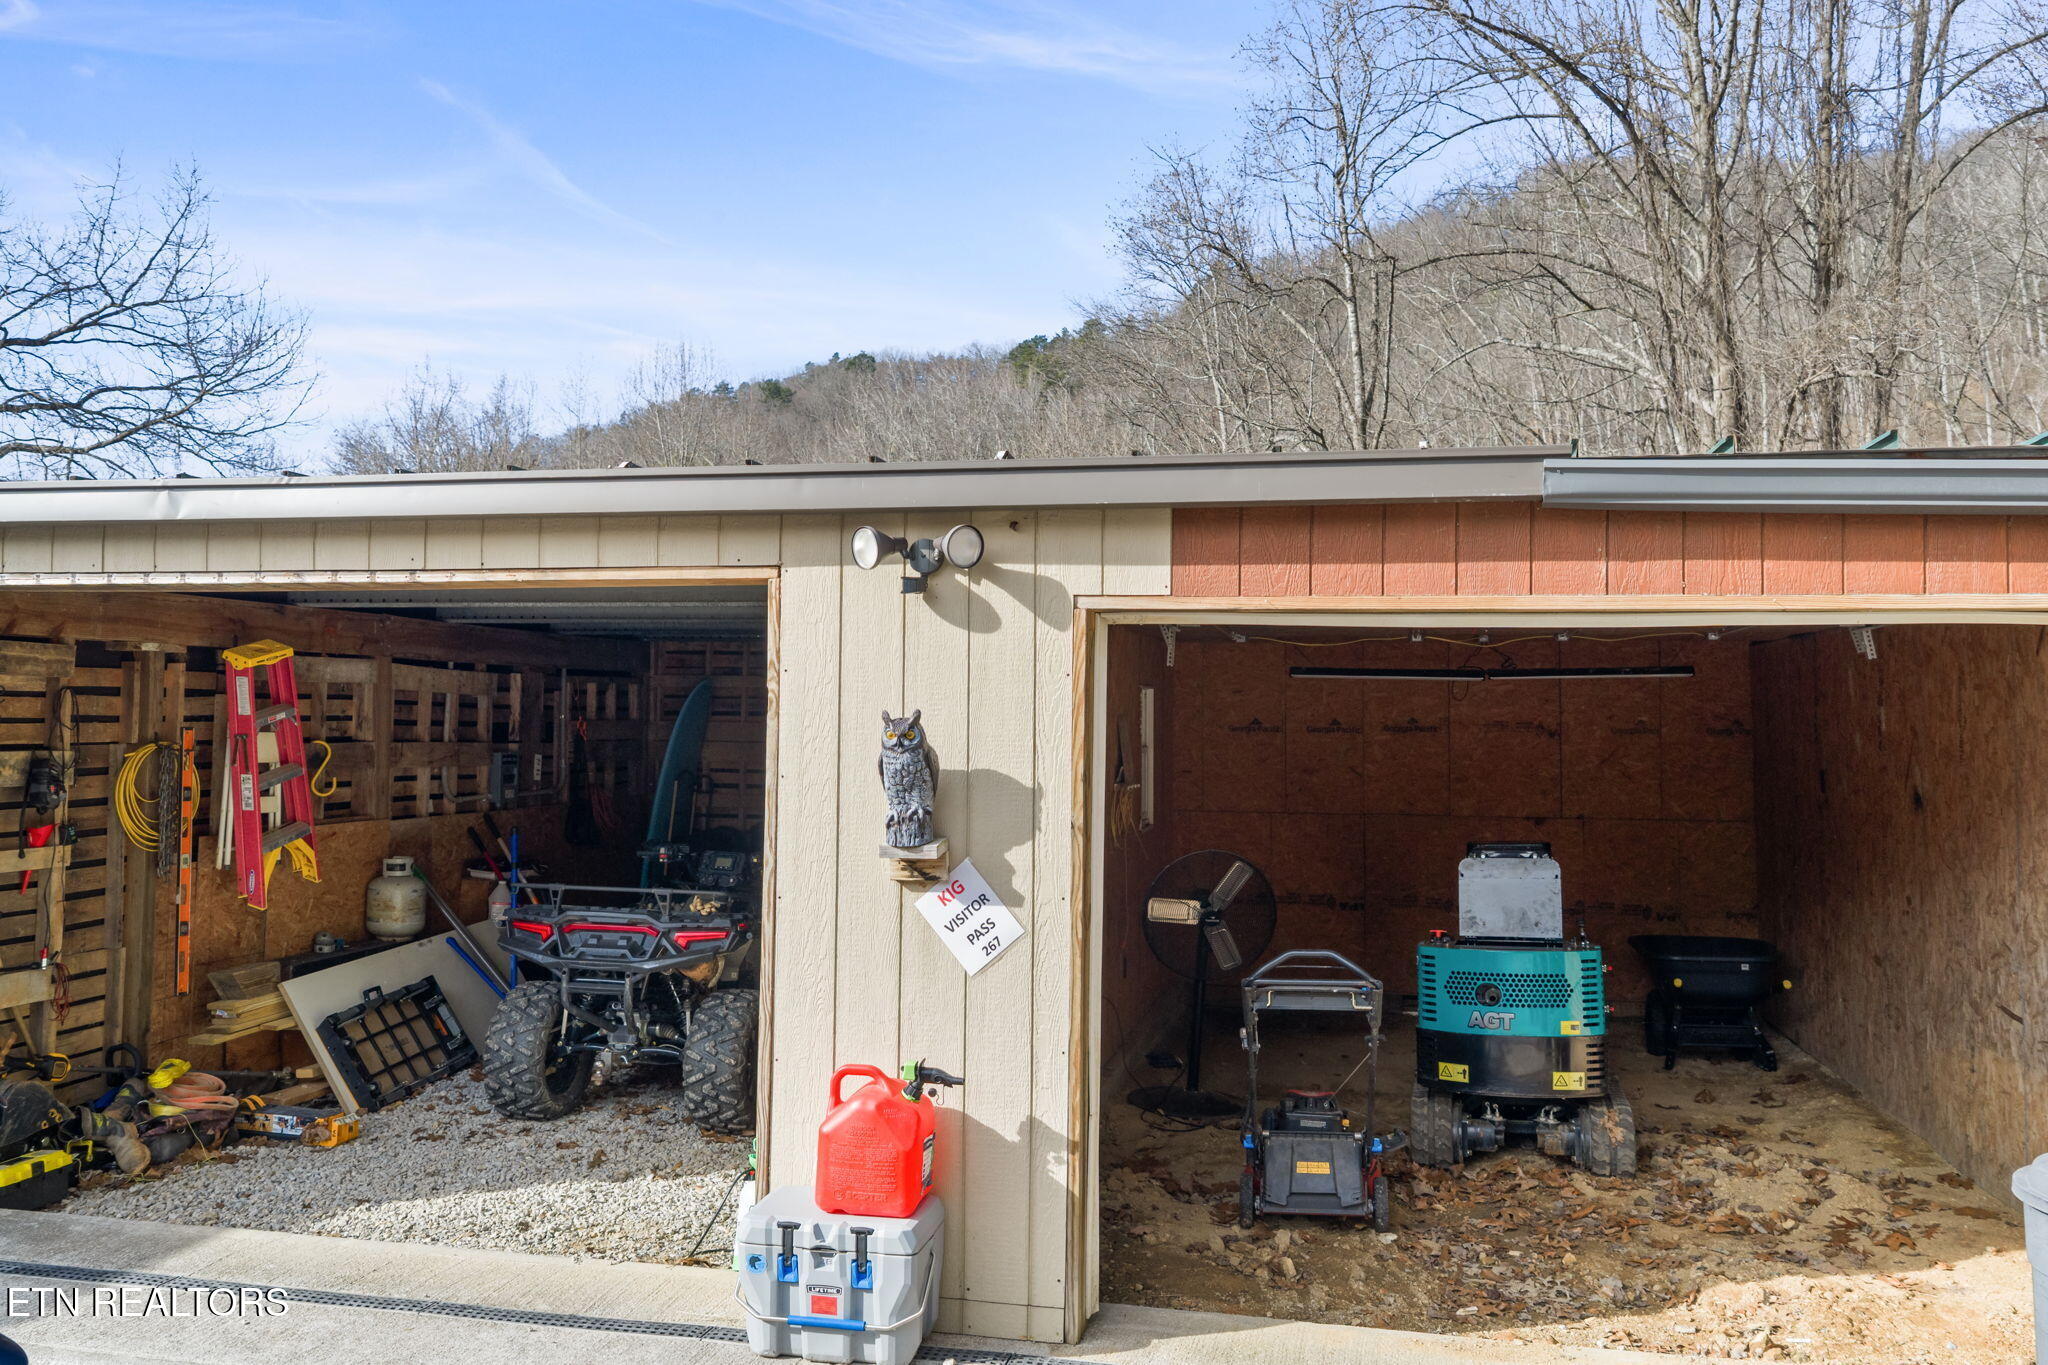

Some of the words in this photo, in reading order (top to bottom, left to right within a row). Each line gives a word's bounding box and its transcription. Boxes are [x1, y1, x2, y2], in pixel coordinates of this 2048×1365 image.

[937, 880, 965, 906] KIG
[944, 893, 990, 933] VISITOR
[967, 918, 996, 945] PASS
[982, 936, 1001, 956] 267
[1468, 1010, 1515, 1031] AGT
